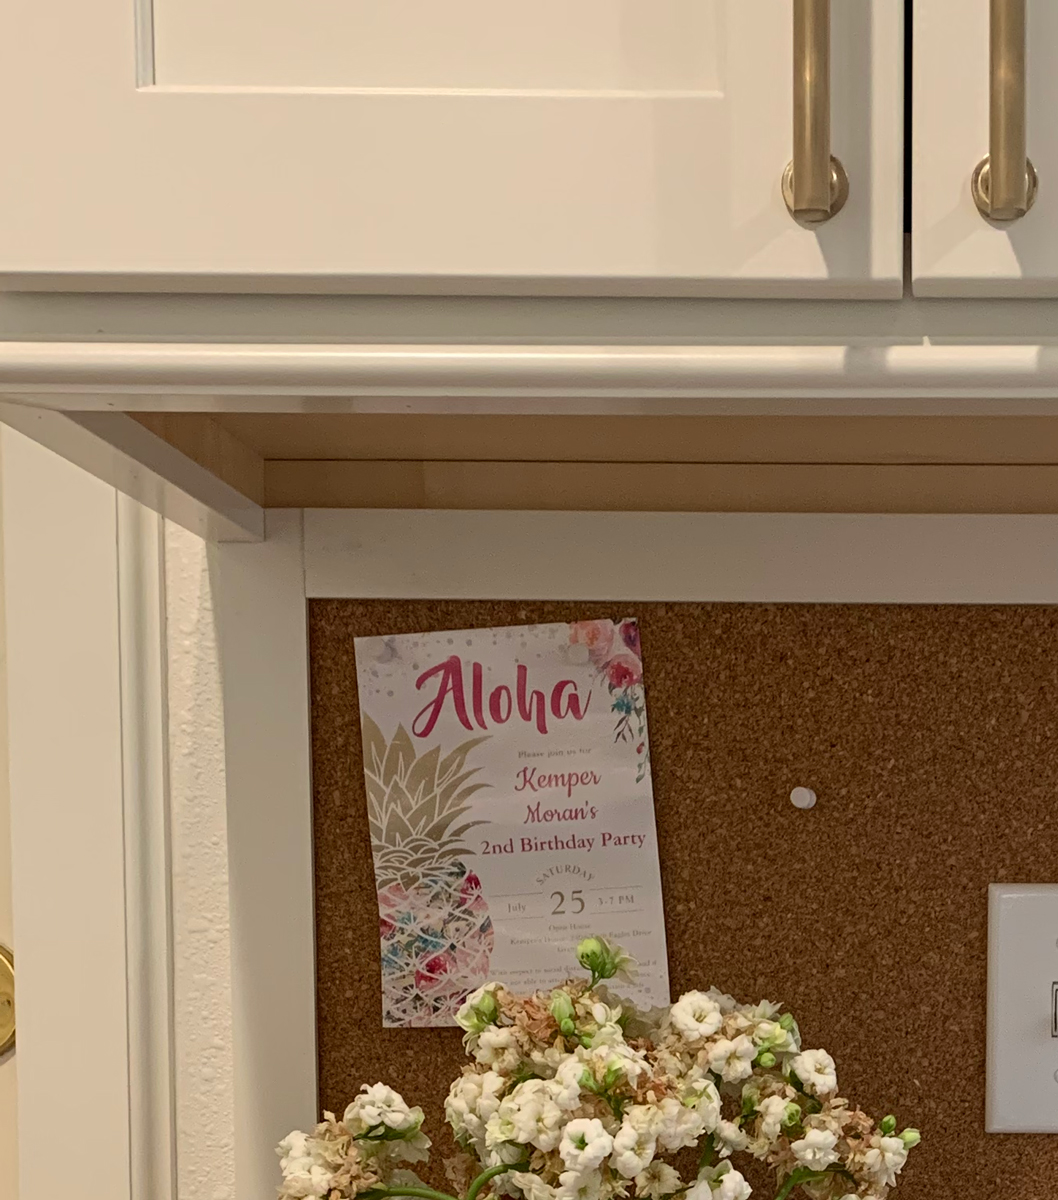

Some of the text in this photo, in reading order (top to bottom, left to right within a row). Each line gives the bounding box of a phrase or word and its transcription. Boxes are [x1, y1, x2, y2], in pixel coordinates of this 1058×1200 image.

[412, 655, 592, 738] Aloha
[518, 750, 544, 760] Please
[547, 749, 564, 759] join
[514, 766, 601, 797] Kemper
[523, 800, 599, 824] Moran's
[481, 832, 646, 855] 2nd Birthday Party
[536, 864, 595, 885] SATURDAY
[507, 903, 526, 914] July
[550, 889, 585, 915] 25
[618, 894, 635, 904] PM
